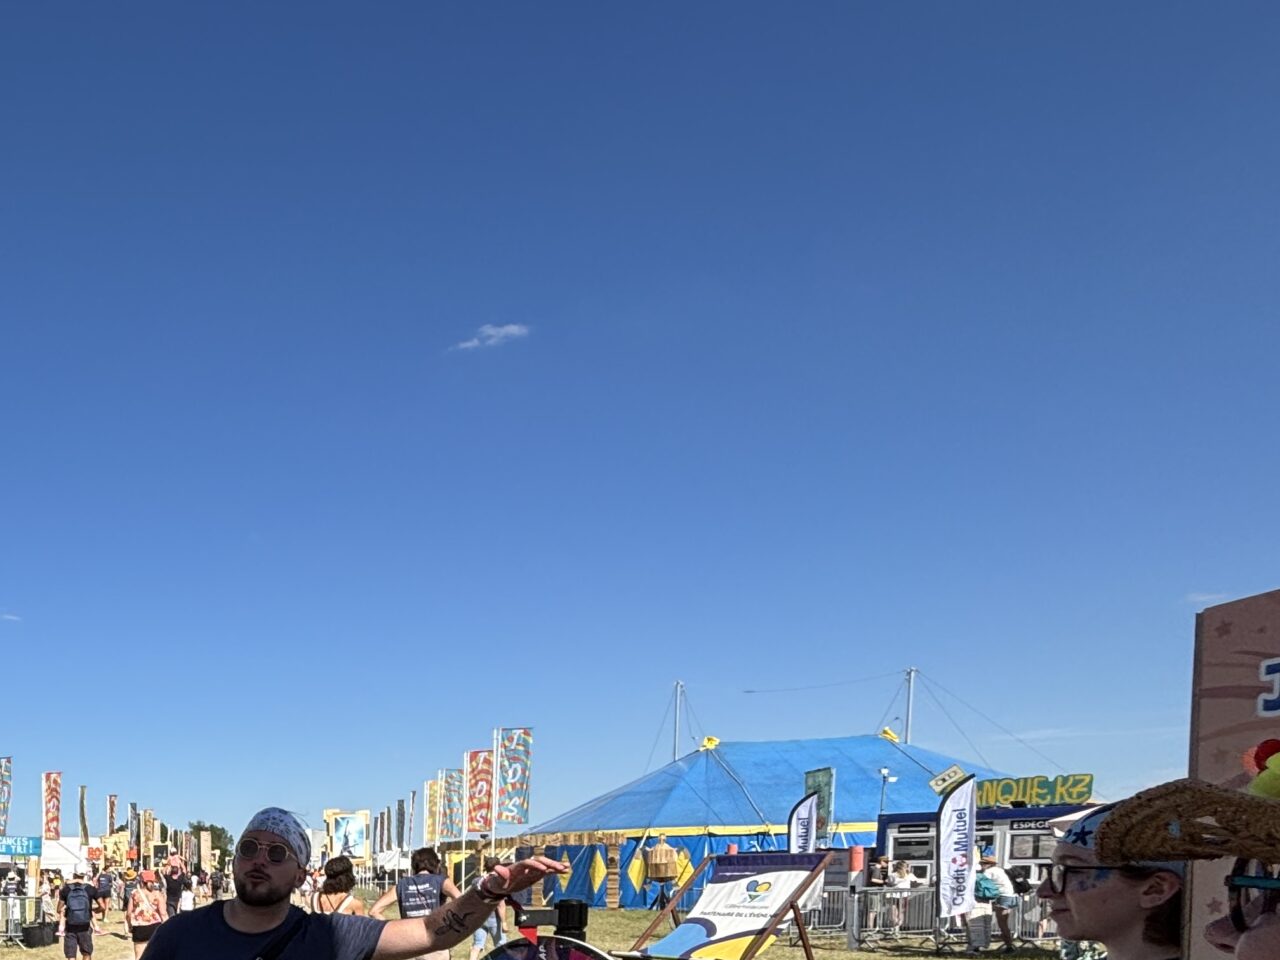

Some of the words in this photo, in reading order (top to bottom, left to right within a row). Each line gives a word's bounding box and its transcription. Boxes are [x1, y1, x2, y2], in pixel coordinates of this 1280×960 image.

[797, 817, 810, 853] Mutuel
[953, 807, 968, 851] Mutuel
[952, 864, 968, 907] Crédit
